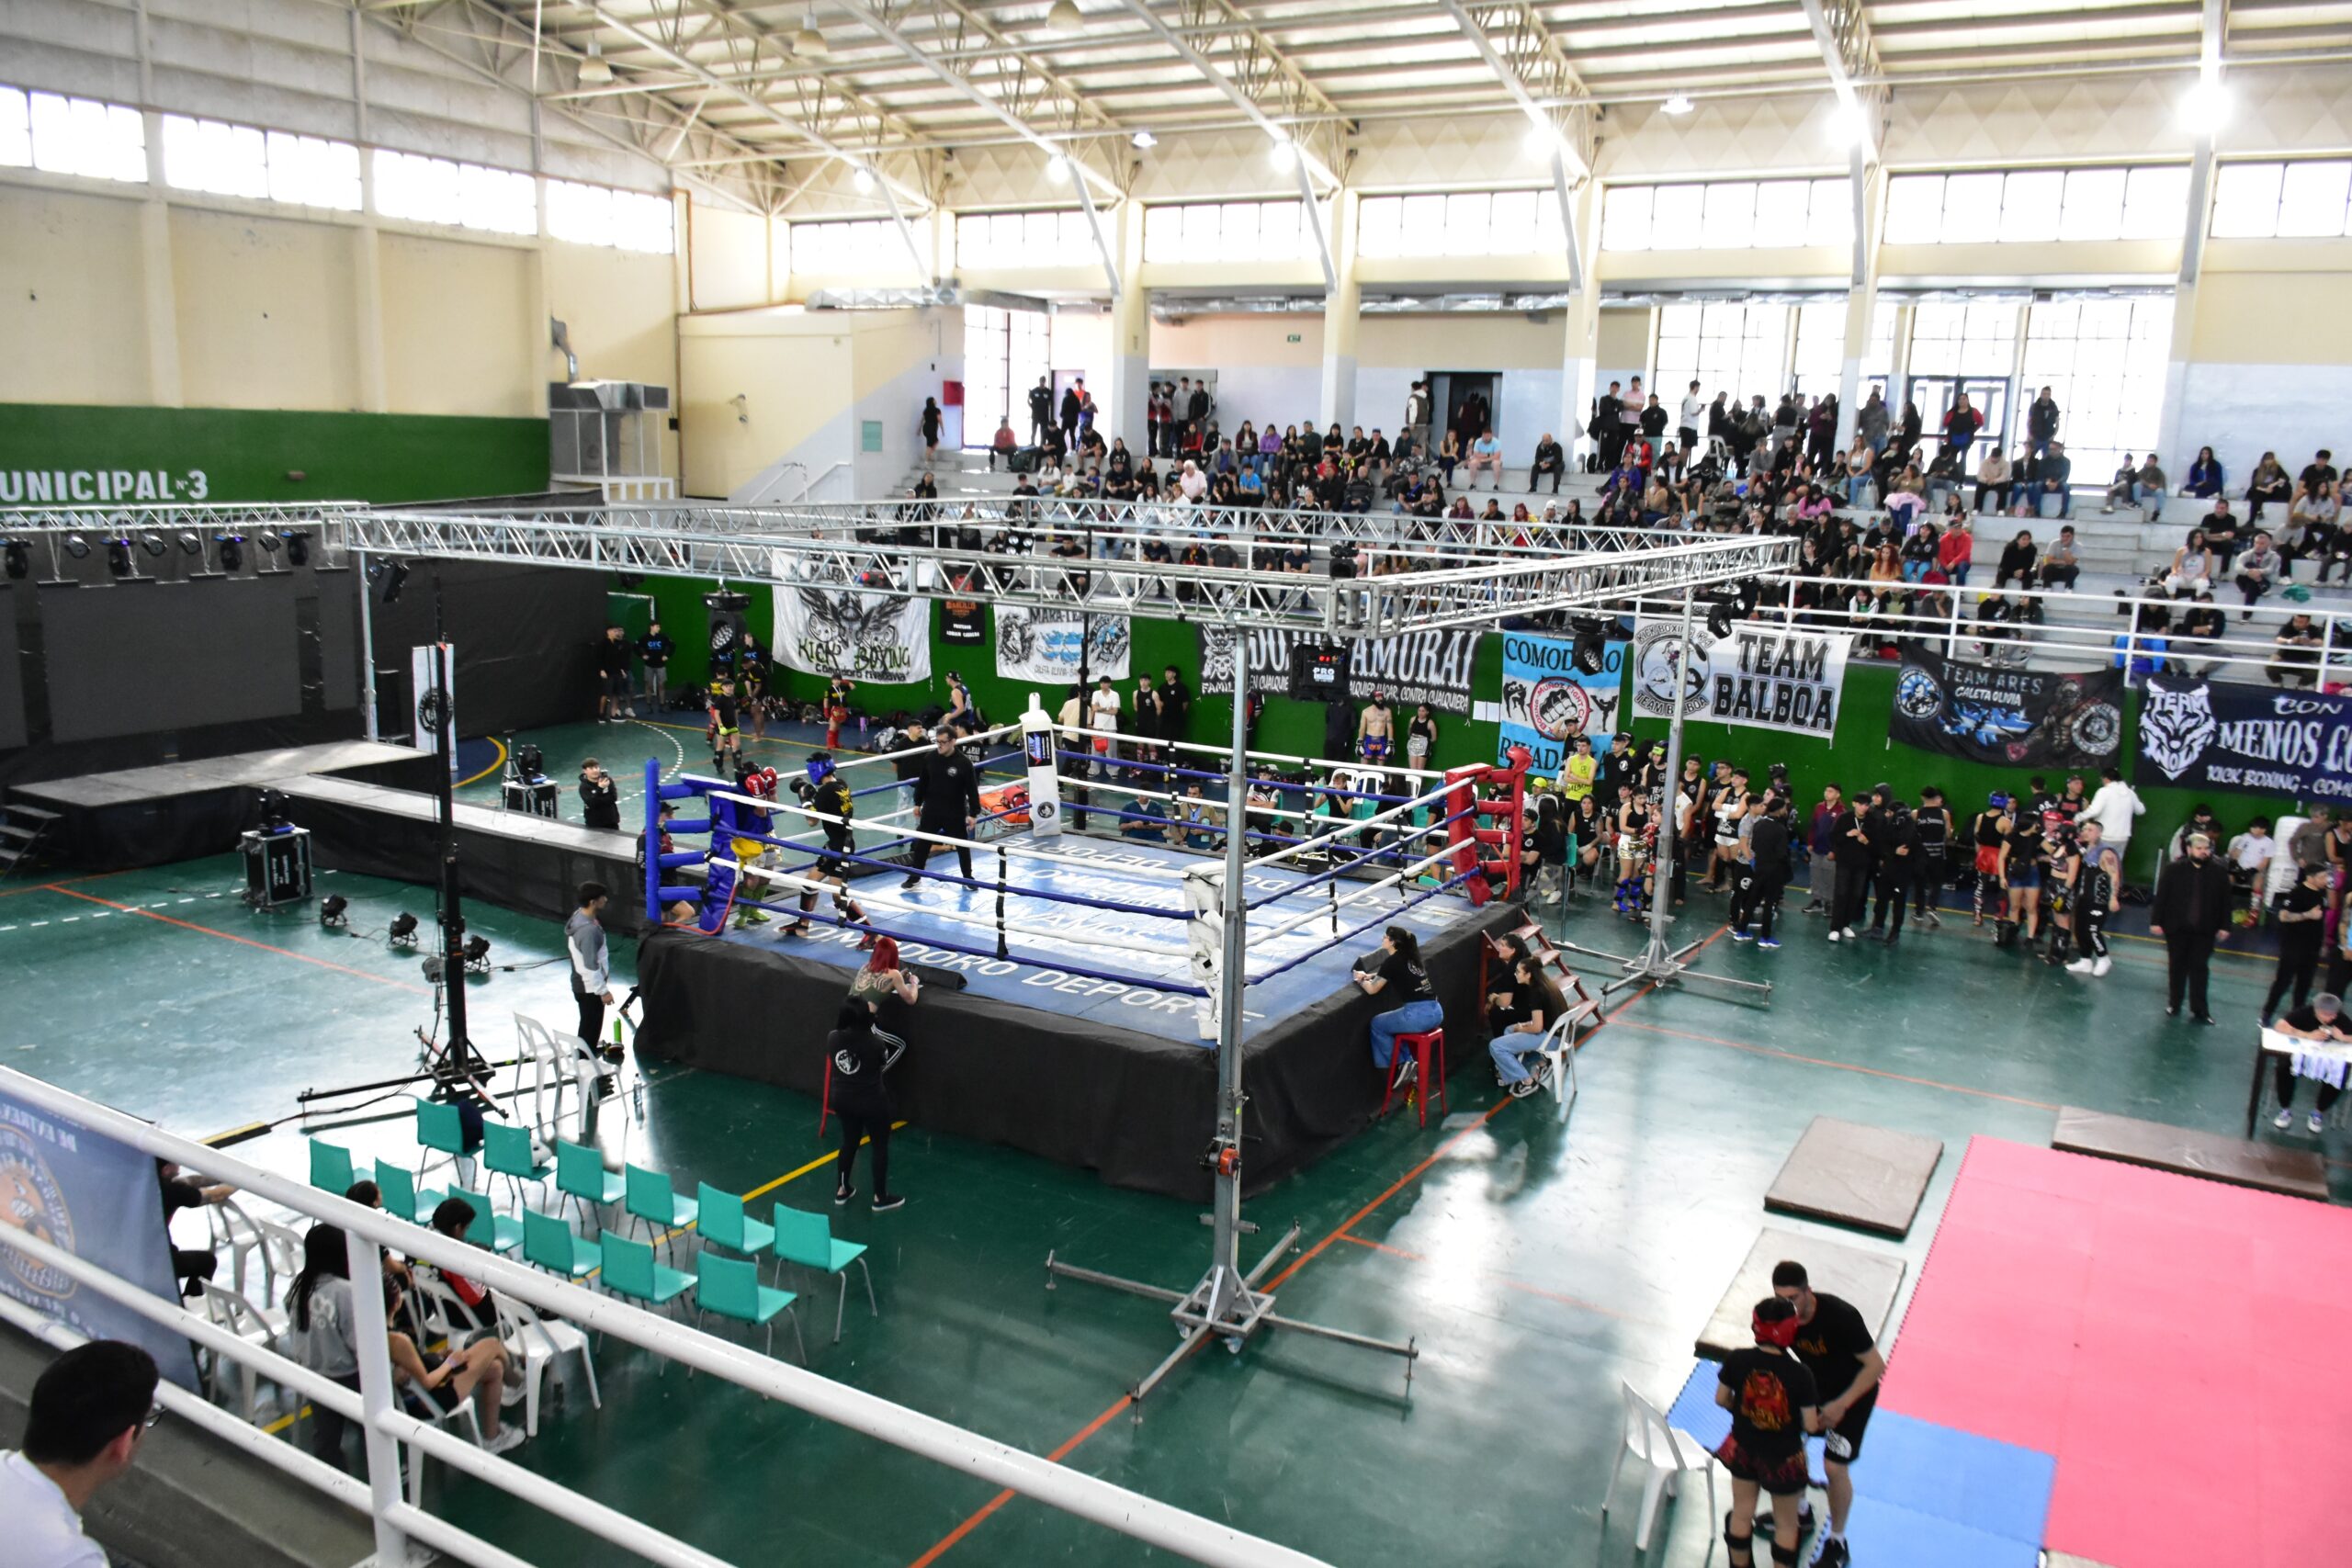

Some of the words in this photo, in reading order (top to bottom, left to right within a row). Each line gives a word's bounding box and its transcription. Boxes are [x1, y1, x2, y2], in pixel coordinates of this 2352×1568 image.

[0, 470, 175, 502] UNICIPAL
[188, 469, 209, 499] 3
[1636, 626, 1657, 642] KICK
[1657, 625, 1696, 637] BOXI
[797, 637, 842, 673] KICK
[854, 645, 910, 673] BOXING
[1505, 637, 1622, 673] COMODO
[1736, 631, 1831, 683] TEAM
[1202, 682, 1236, 694] FAMIL
[1259, 675, 1289, 692] CUALQUIE
[1942, 662, 1989, 686] TEAM
[1996, 674, 2043, 695] ARES
[1955, 686, 1992, 702] CALETA
[1636, 693, 1664, 714] TEAM
[1666, 695, 1707, 716] BBOA
[1711, 674, 1835, 733] BALBOA
[2272, 697, 2344, 715] CON
[2217, 719, 2324, 769] MENOS
[2207, 764, 2243, 784] KICK
[2243, 769, 2301, 794] BOXING
[773, 926, 1019, 976] OMDORO
[1021, 970, 1266, 1023] DEPOR
